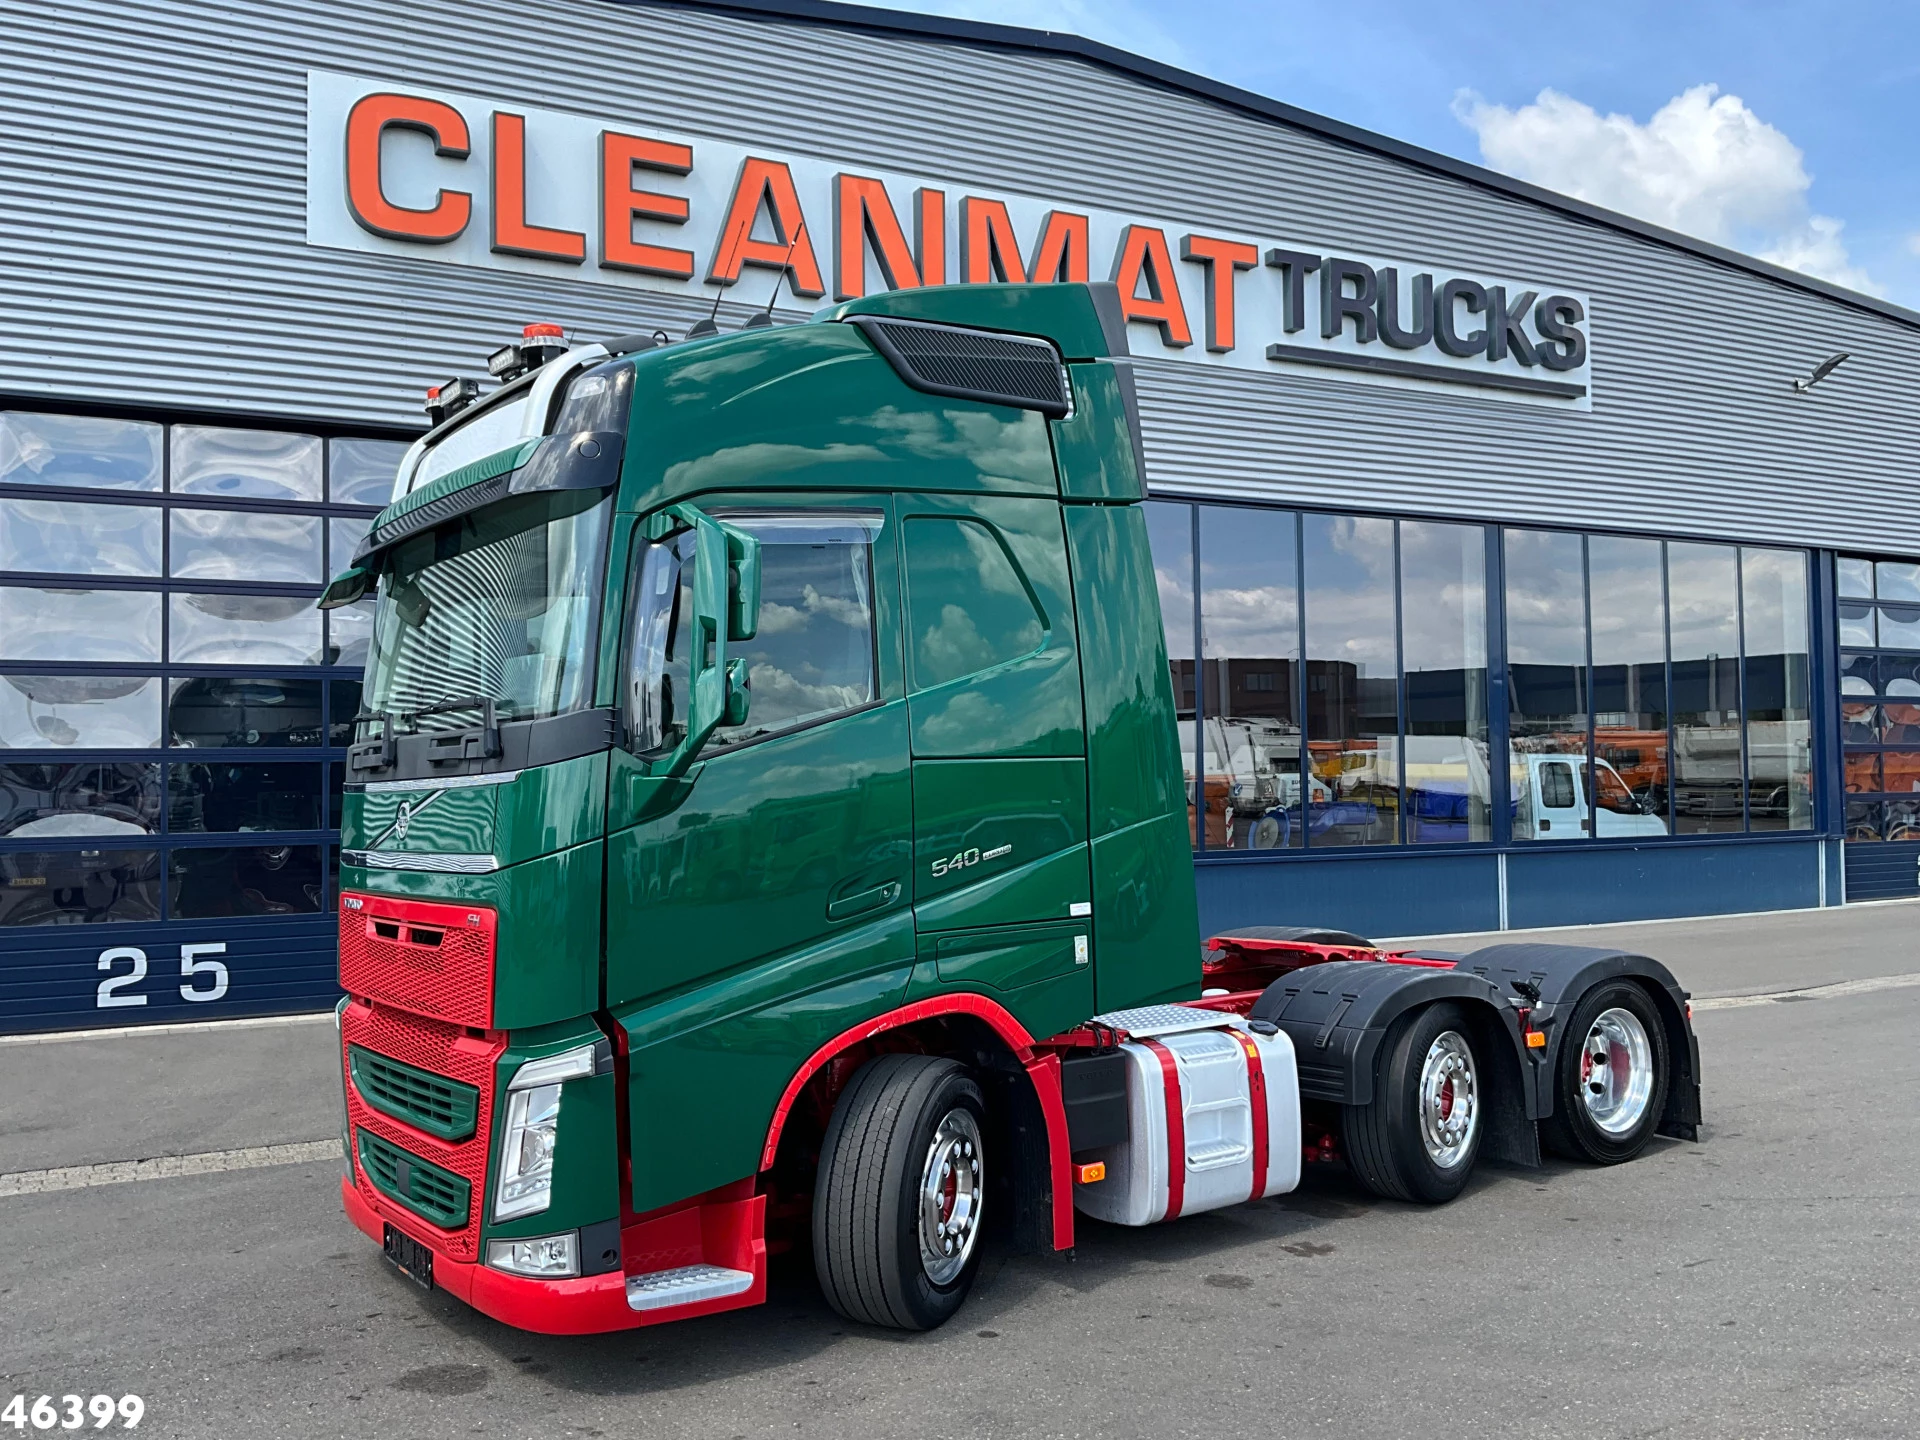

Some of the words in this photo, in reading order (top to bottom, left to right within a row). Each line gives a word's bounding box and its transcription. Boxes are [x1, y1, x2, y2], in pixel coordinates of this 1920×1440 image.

[345, 92, 1258, 353] CLEANMAT
[1265, 248, 1587, 371] TRUCKS
[931, 847, 980, 877] 540
